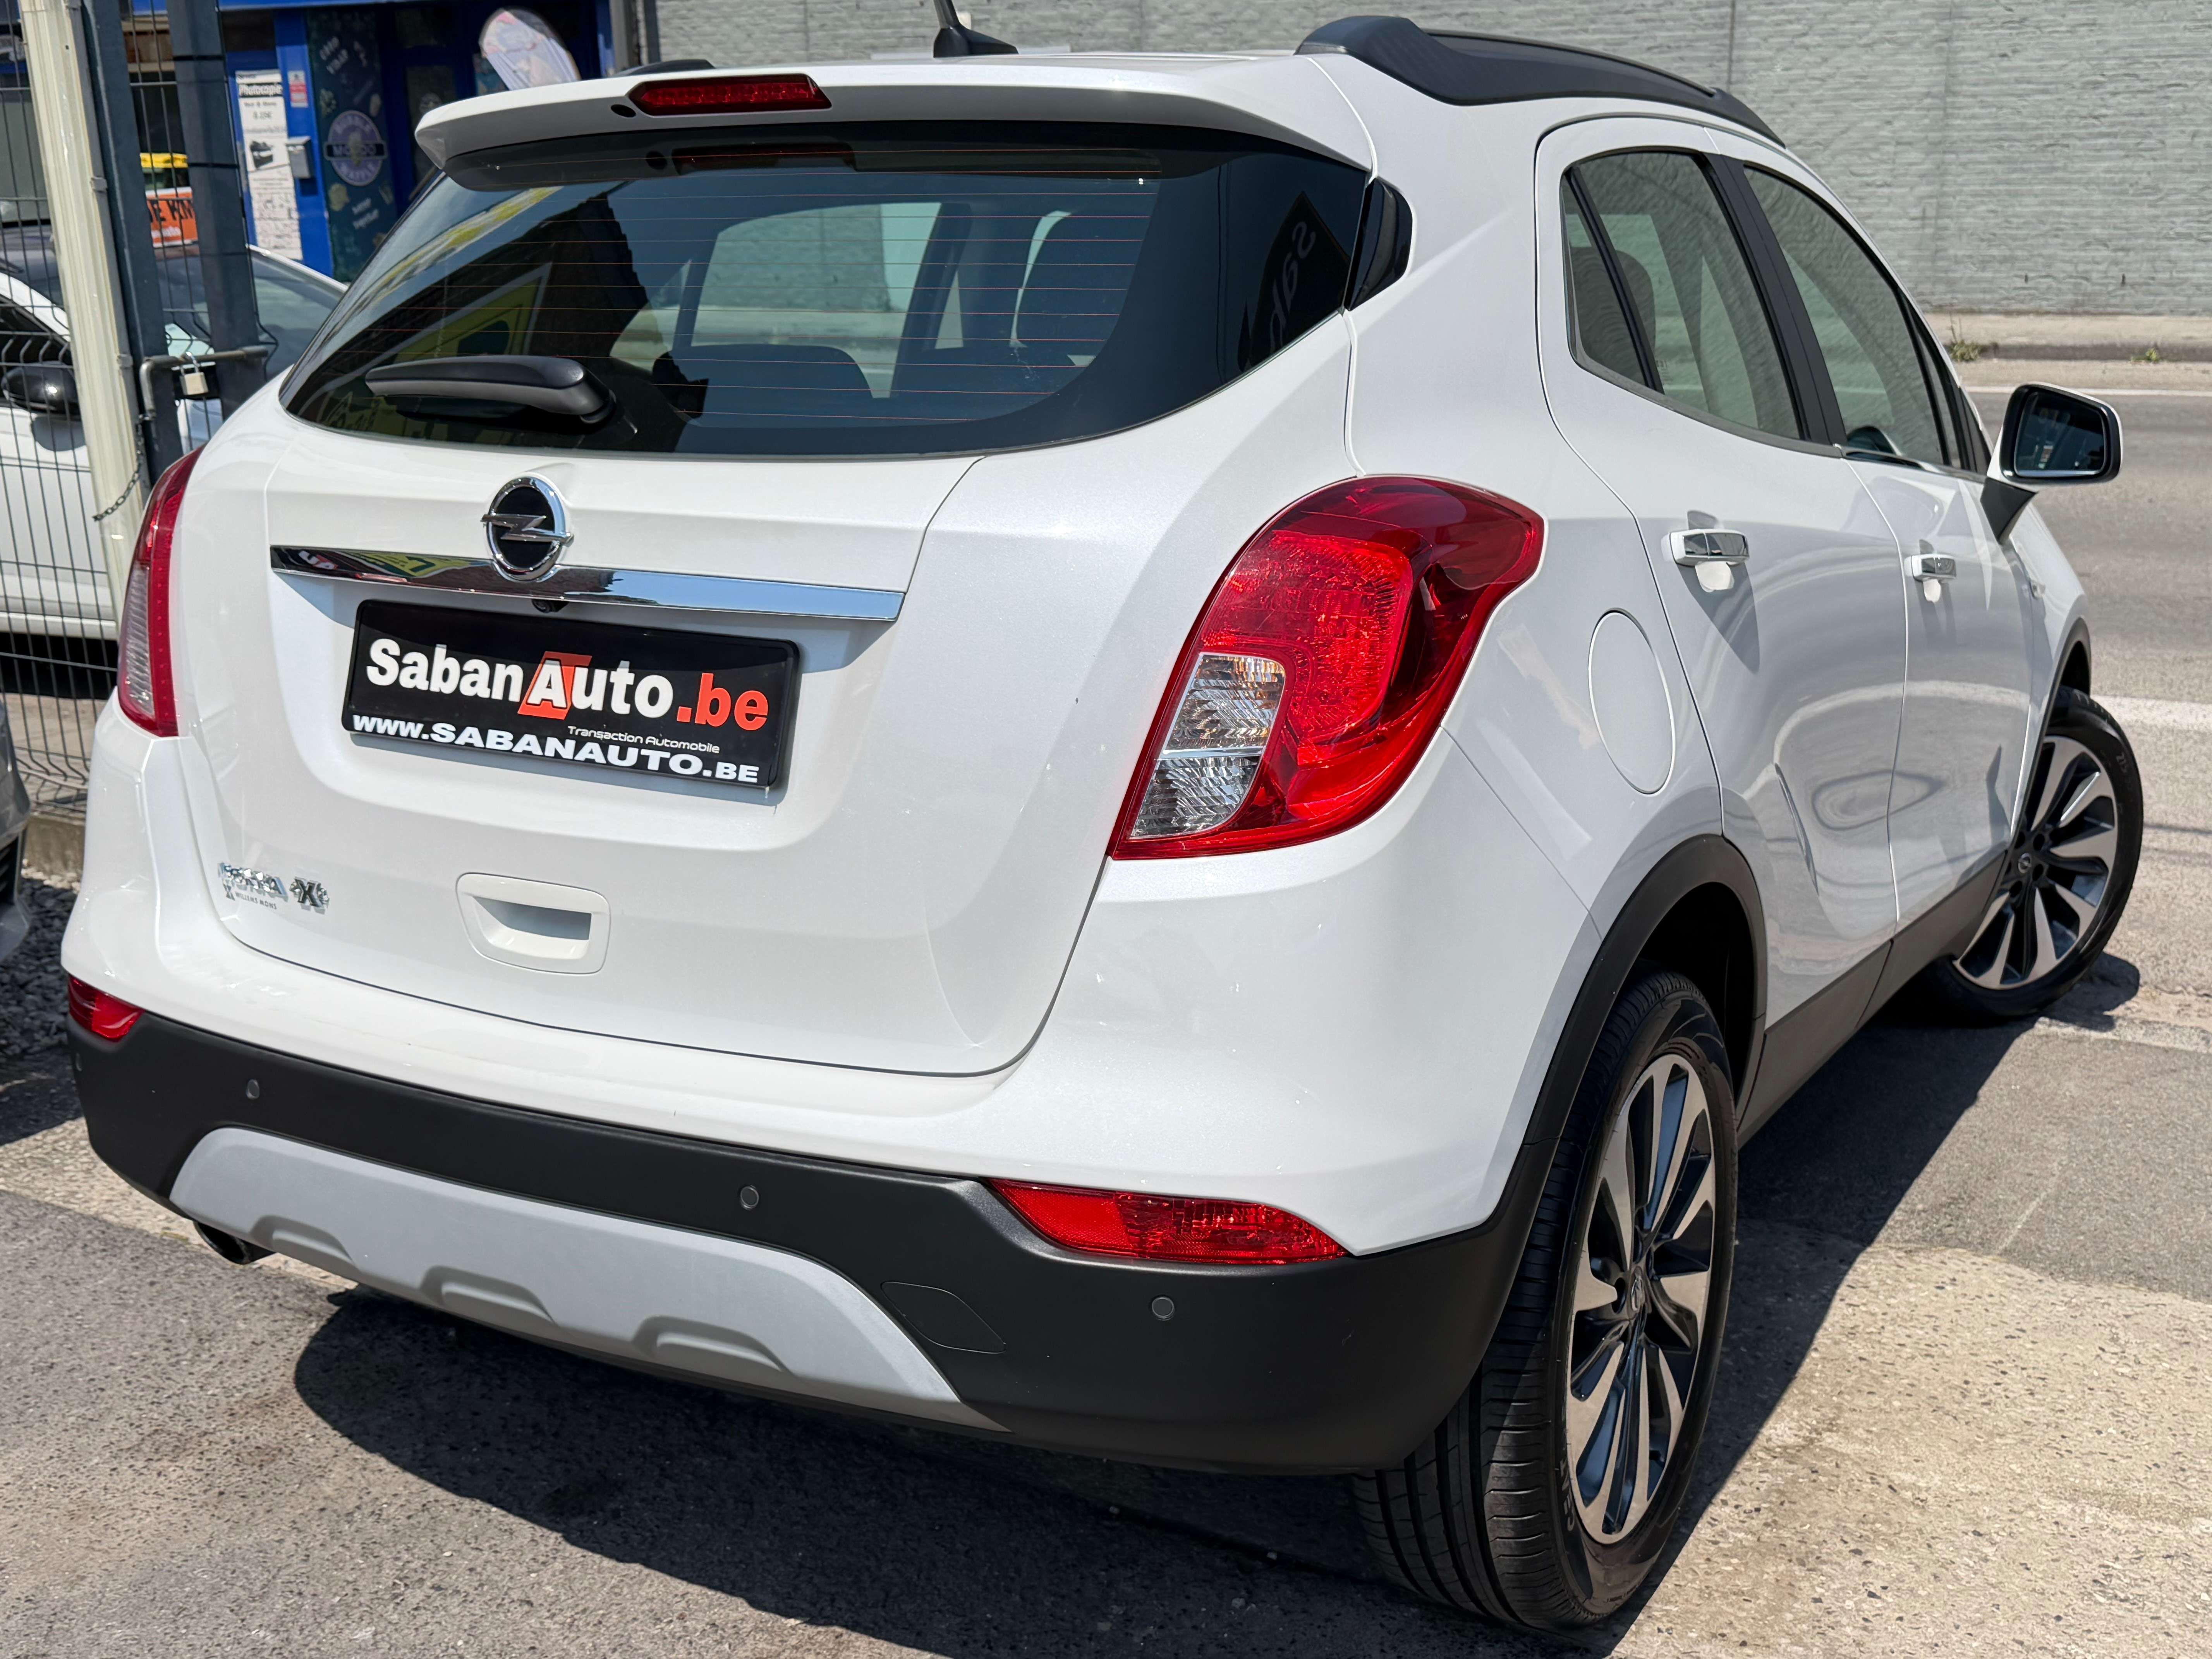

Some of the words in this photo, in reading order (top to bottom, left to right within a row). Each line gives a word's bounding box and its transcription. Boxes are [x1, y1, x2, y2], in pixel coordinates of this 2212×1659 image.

[367, 638, 768, 730] SabanAuto.be
[568, 726, 643, 744] Transaction
[646, 736, 720, 754] Automobile
[260, 899, 277, 910] MONS
